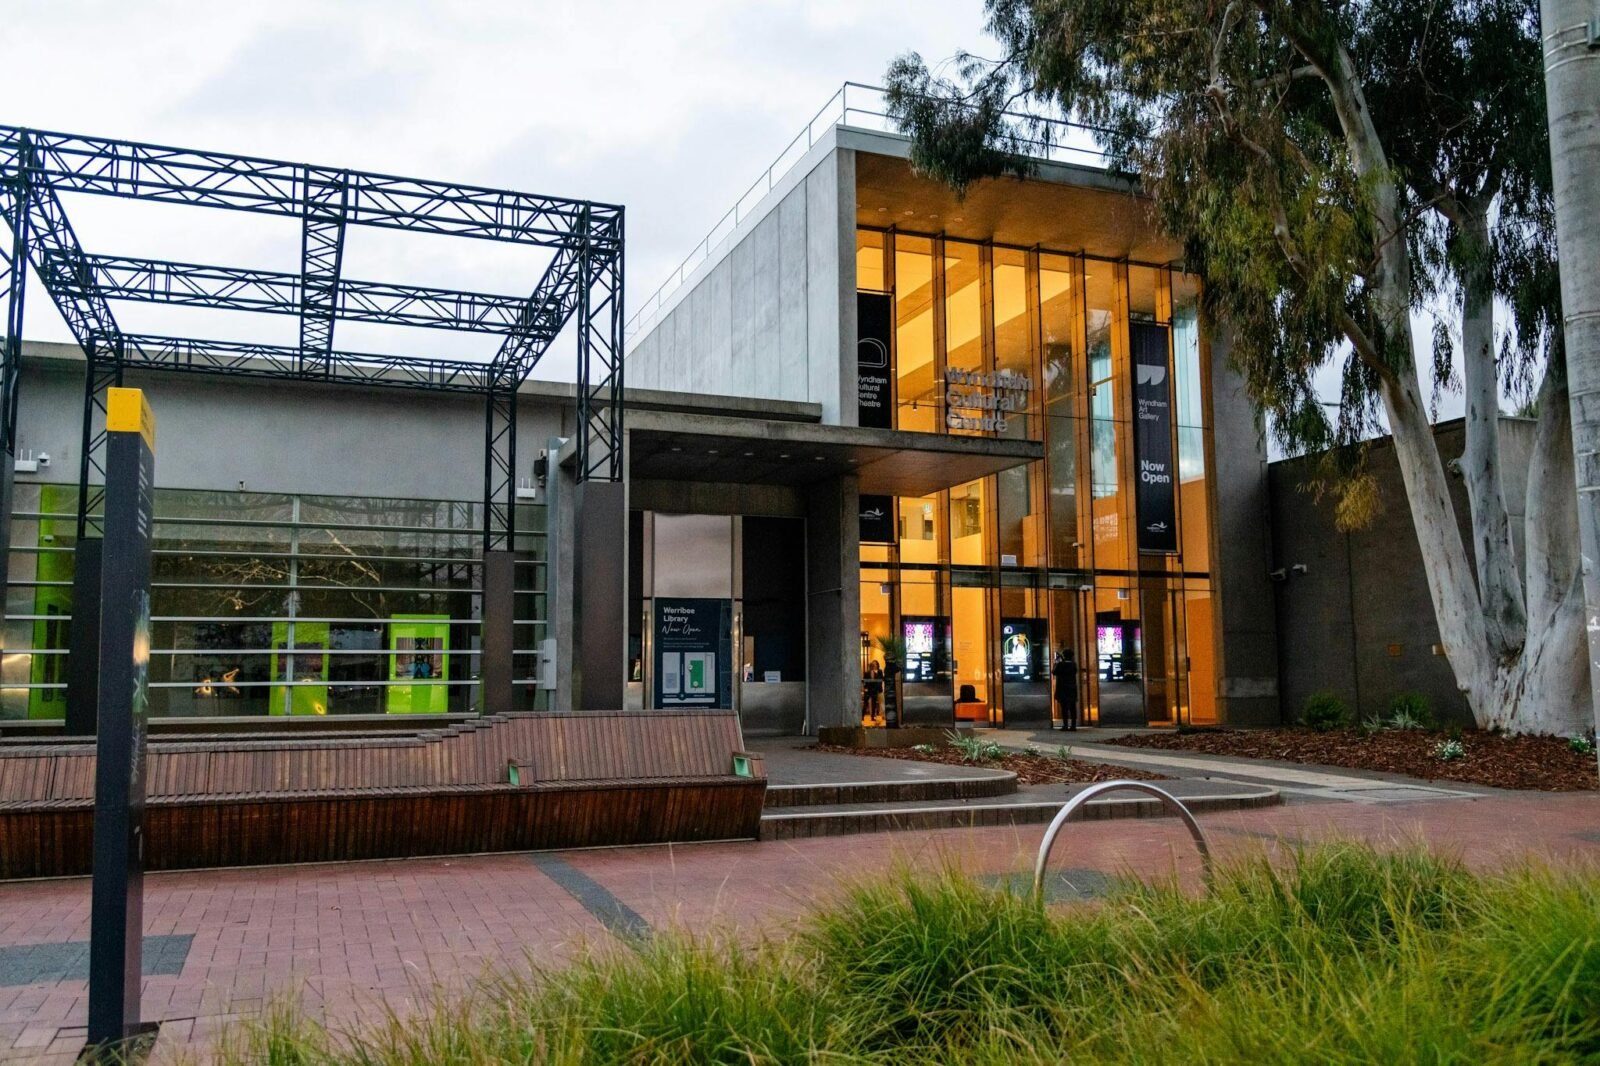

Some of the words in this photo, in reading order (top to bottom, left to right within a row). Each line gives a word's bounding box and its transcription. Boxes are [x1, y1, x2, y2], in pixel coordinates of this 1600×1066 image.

[945, 366, 1033, 391] Wyndham
[946, 389, 1015, 411] Cultural
[1138, 398, 1167, 407] Wyndham
[946, 409, 1008, 432] Centre
[1138, 411, 1160, 421] Gallery
[1141, 460, 1165, 472] Now
[1141, 471, 1170, 484] Open
[663, 615, 689, 623] Library
[661, 622, 680, 634] Now
[682, 624, 701, 635] Open
